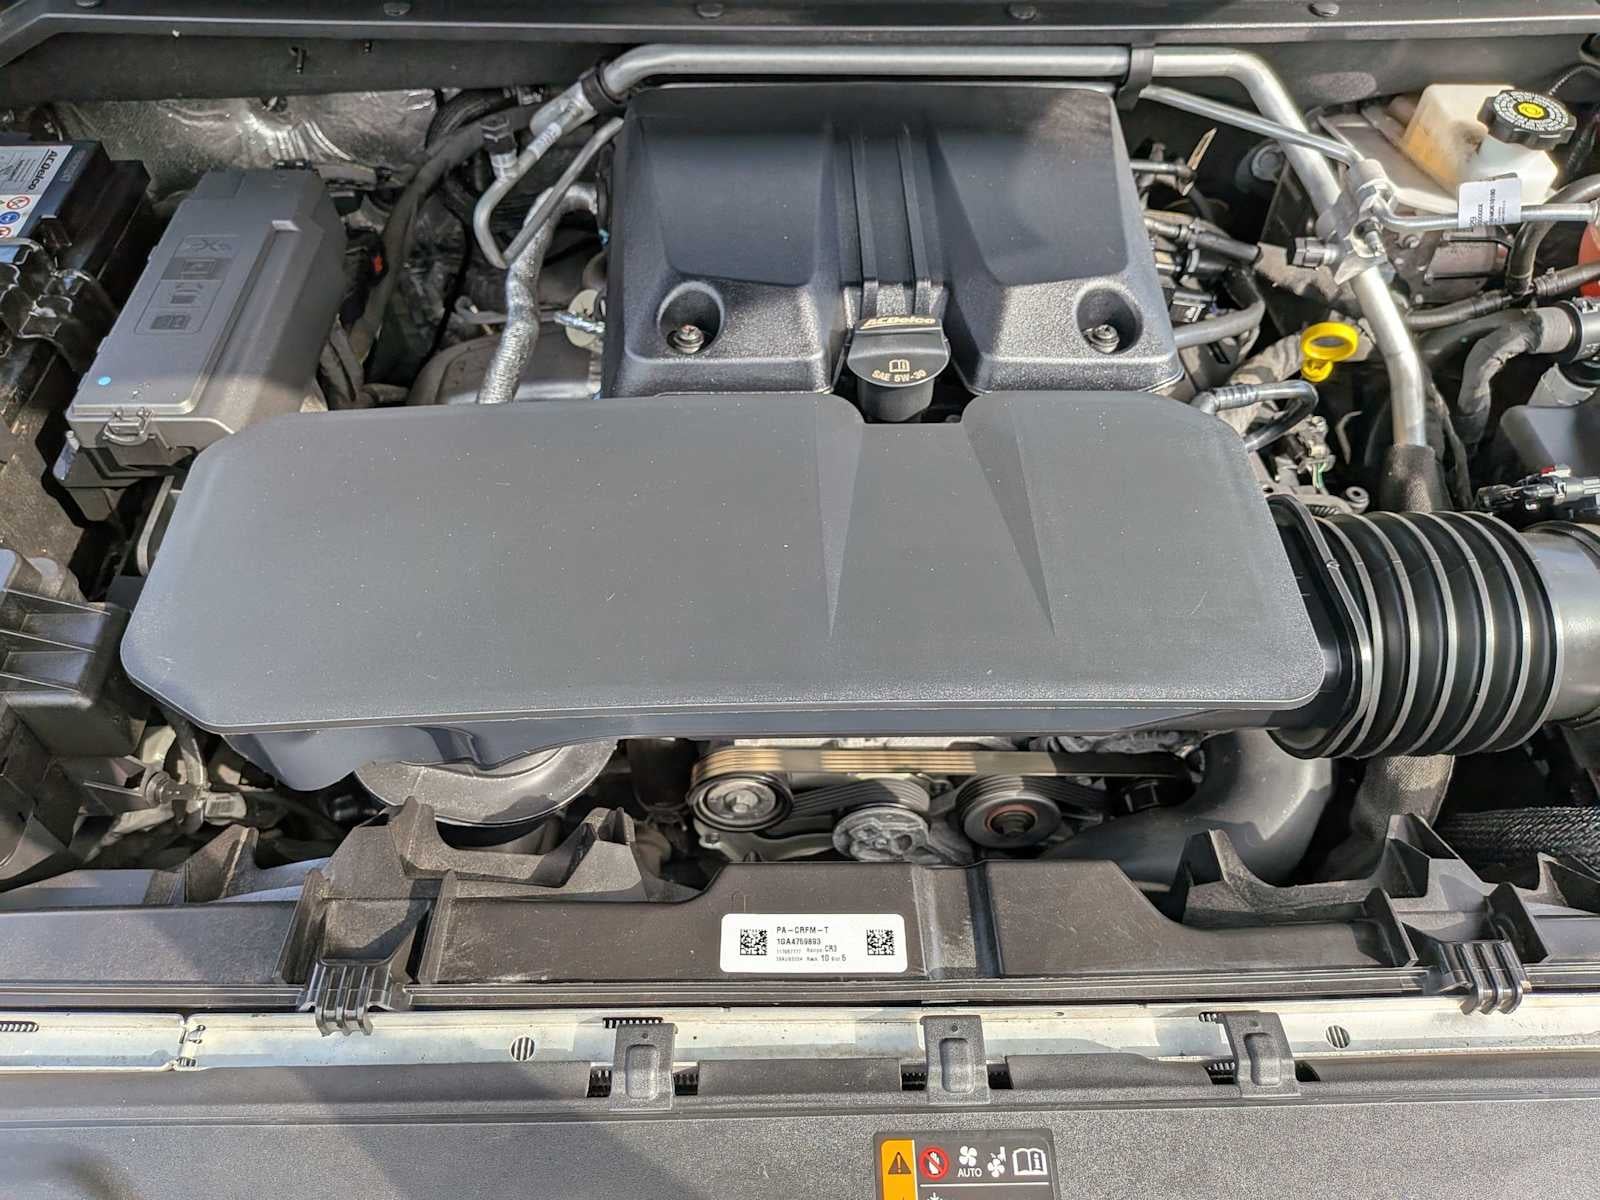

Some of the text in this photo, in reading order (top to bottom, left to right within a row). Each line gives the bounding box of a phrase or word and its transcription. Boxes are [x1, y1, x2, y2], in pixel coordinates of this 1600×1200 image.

[28, 150, 58, 190] ACDelco
[863, 316, 936, 327] ACDelco
[872, 369, 928, 382] SAE 5W-30
[821, 954, 829, 962] 10
[957, 1167, 983, 1178] AUTO
